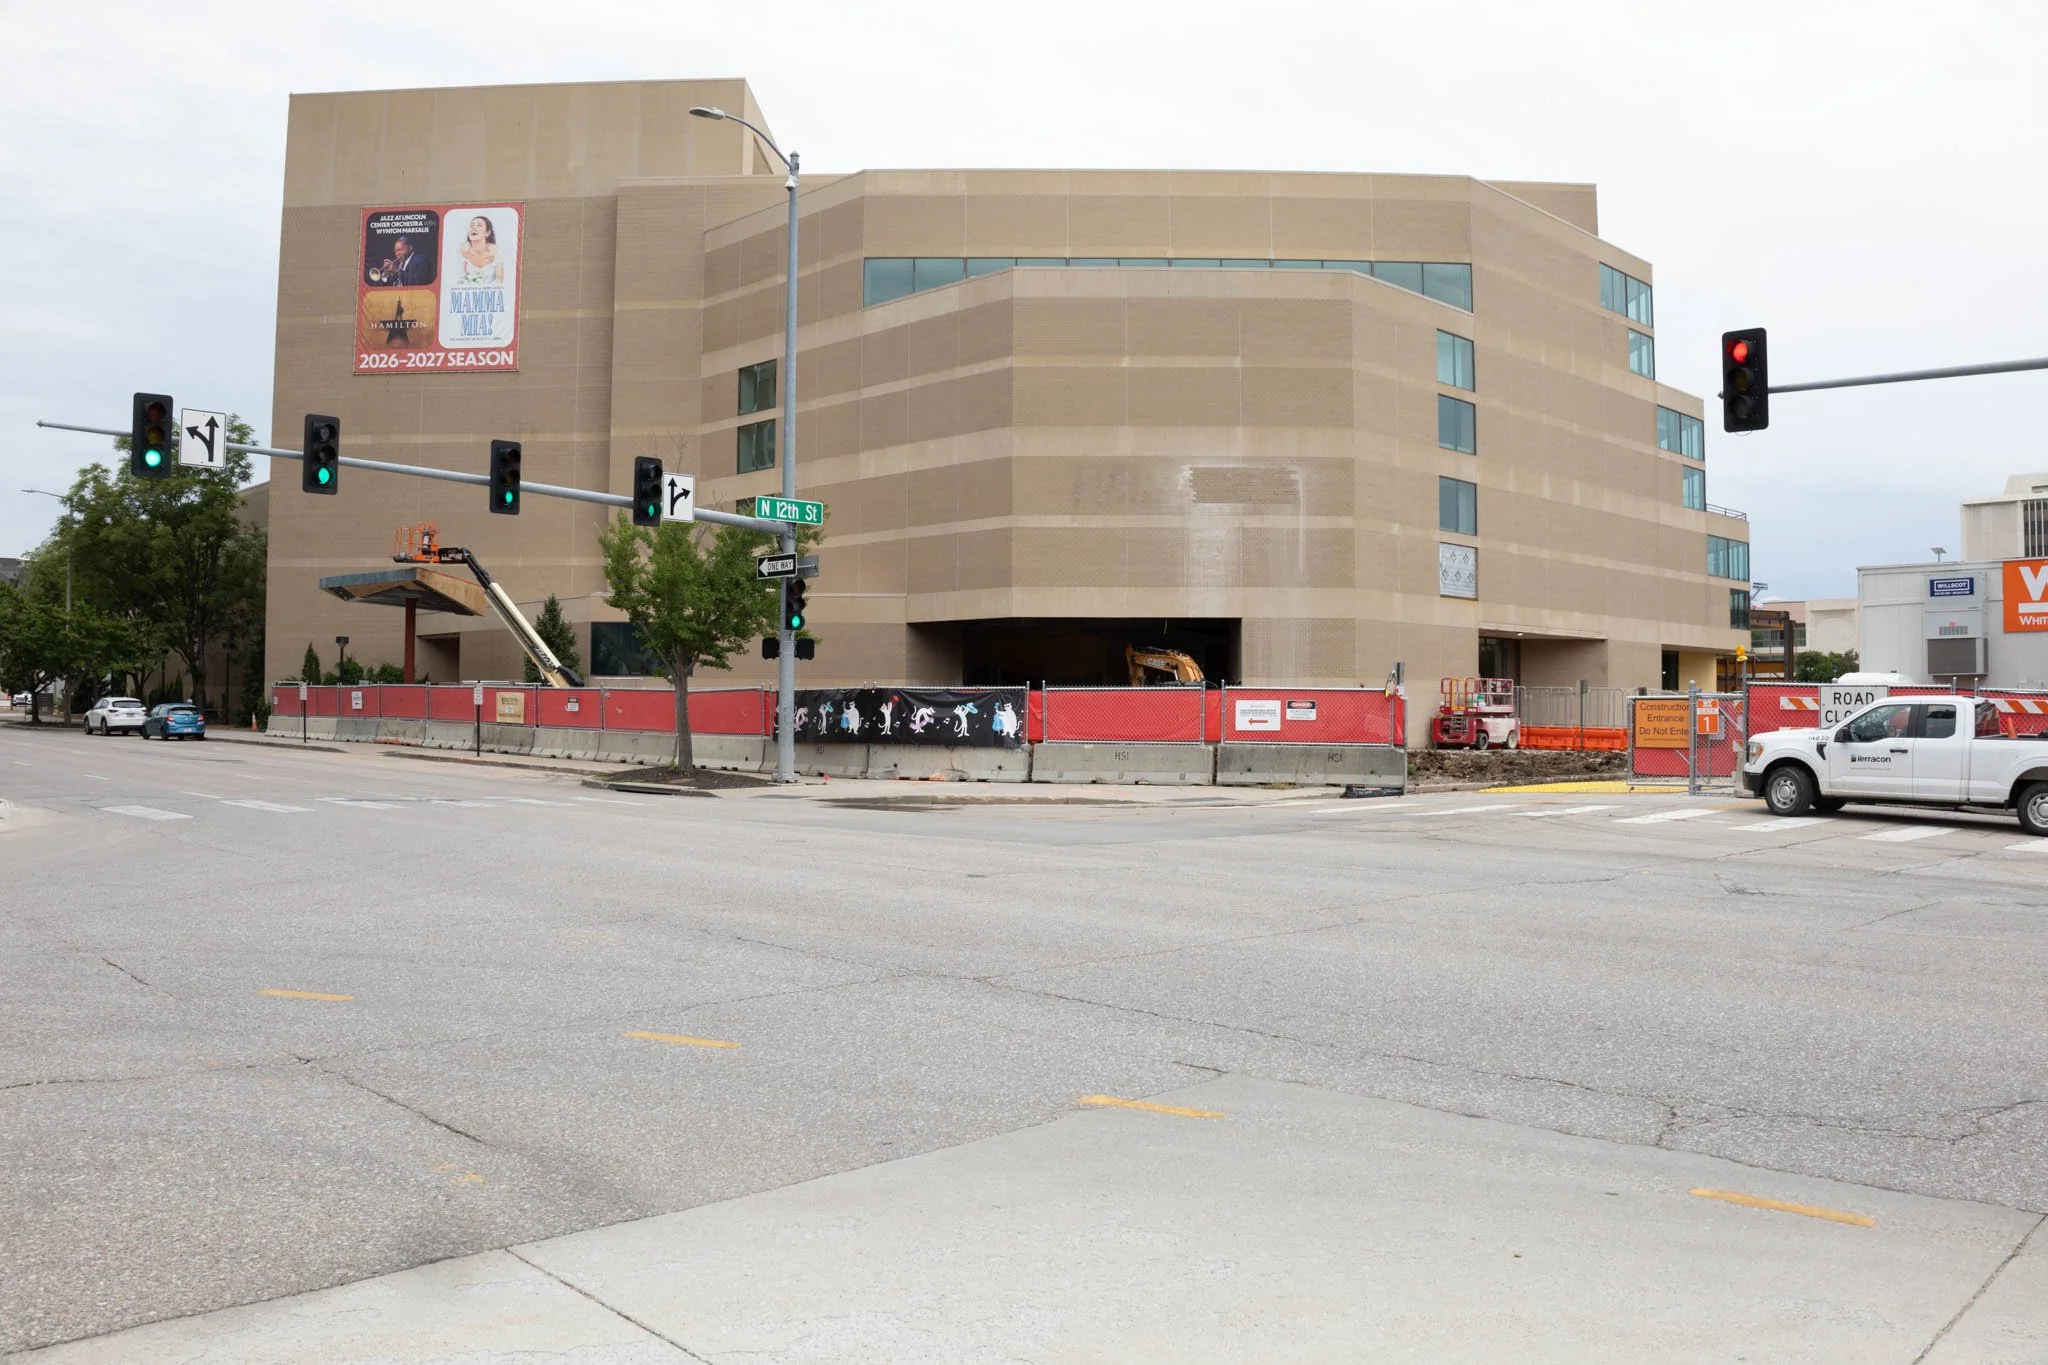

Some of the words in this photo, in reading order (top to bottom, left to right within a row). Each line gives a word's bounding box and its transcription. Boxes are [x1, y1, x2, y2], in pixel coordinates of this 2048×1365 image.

[449, 290, 504, 313] MAMMA
[371, 321, 427, 329] HAMILTON
[461, 313, 493, 336] MIA!
[447, 351, 514, 367] SEASON
[761, 499, 770, 517] N
[776, 501, 799, 519] 12th
[805, 504, 817, 521] St
[767, 562, 779, 571] ONE
[780, 560, 792, 569] WAY
[1833, 692, 1875, 705] ROAD
[1640, 702, 1689, 711] Constructio
[1647, 713, 1685, 722] Entrance
[1825, 710, 1853, 723] CLO
[1703, 716, 1710, 732] 1
[1639, 727, 1651, 735] Do
[1653, 727, 1668, 736] Not
[1670, 727, 1689, 736] Ente
[1115, 751, 1129, 761] HSI
[1328, 752, 1343, 763] HSI
